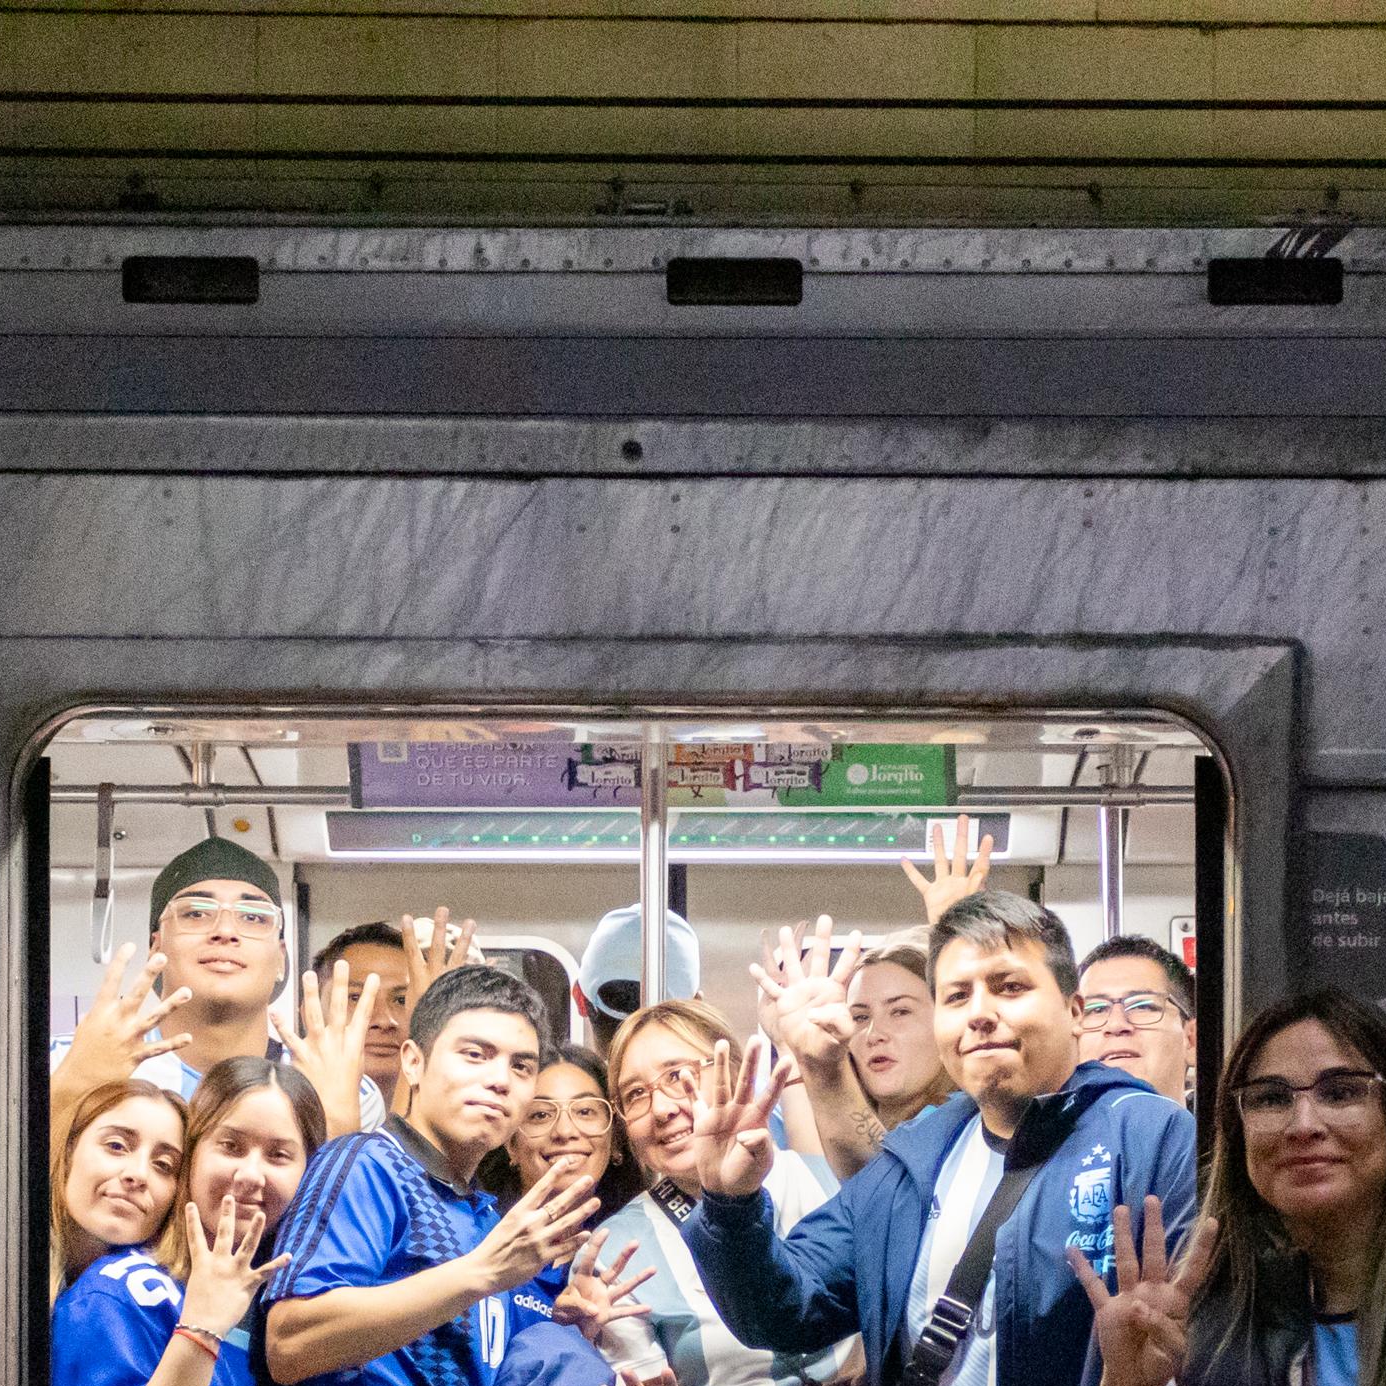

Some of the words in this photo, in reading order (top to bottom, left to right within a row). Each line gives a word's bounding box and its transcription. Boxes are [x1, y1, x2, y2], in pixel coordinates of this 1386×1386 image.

[416, 755, 457, 769] QUE
[463, 755, 488, 769] ES
[493, 755, 558, 769] PARTE
[417, 773, 444, 786] DE
[449, 773, 473, 786] TU
[1312, 911, 1359, 926] antes
[1312, 932, 1334, 948] de
[1337, 932, 1382, 948] subir
[513, 1294, 554, 1319] adidas
